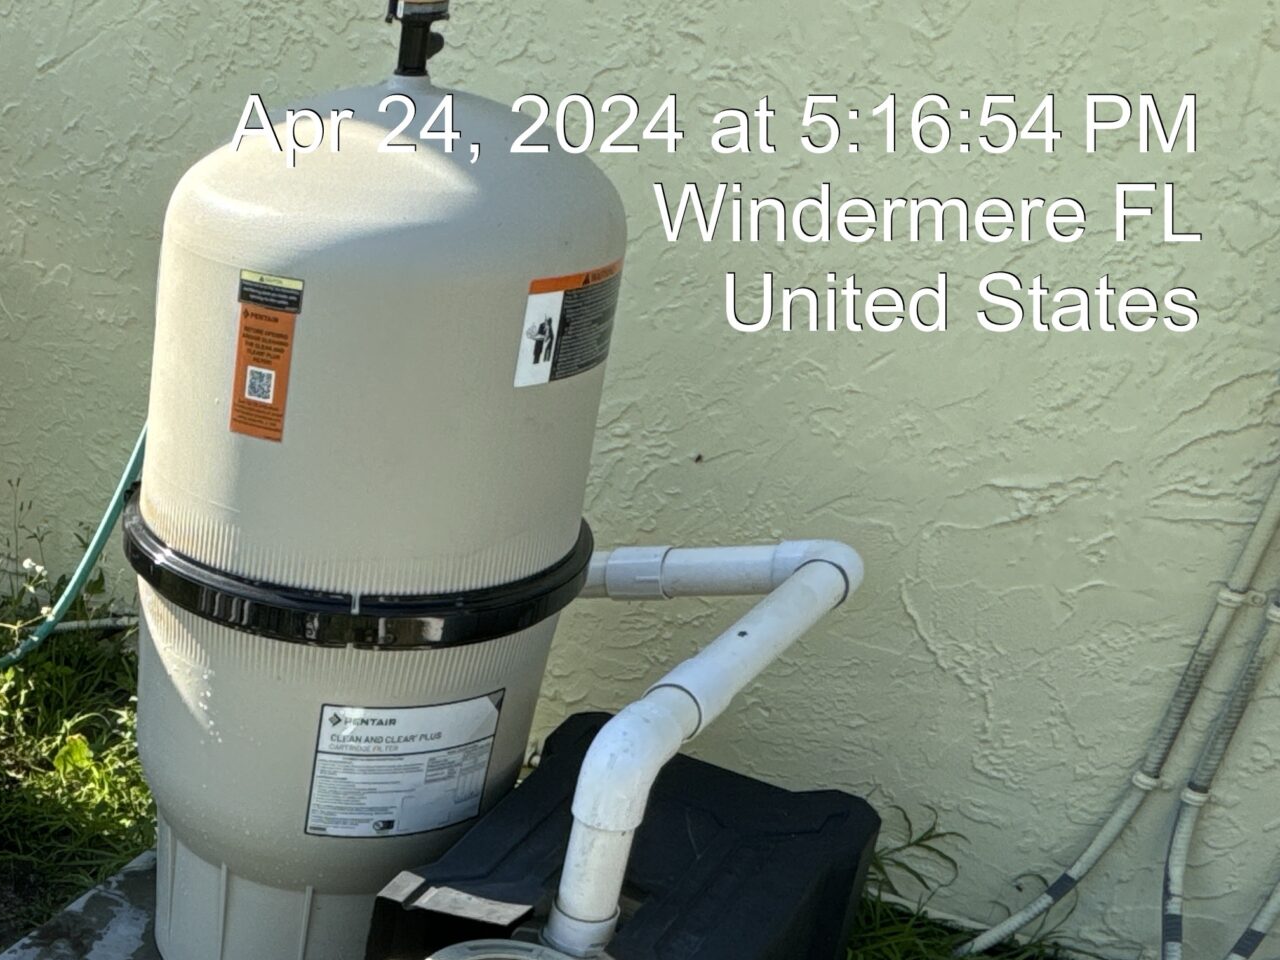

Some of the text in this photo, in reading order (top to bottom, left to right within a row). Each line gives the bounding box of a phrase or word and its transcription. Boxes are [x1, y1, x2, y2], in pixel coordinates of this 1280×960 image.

[343, 718, 397, 727] PENTAIR
[330, 733, 361, 743] CLEAN
[363, 735, 383, 744] AND
[419, 731, 442, 742] PLUS
[372, 744, 399, 753] FILTER
